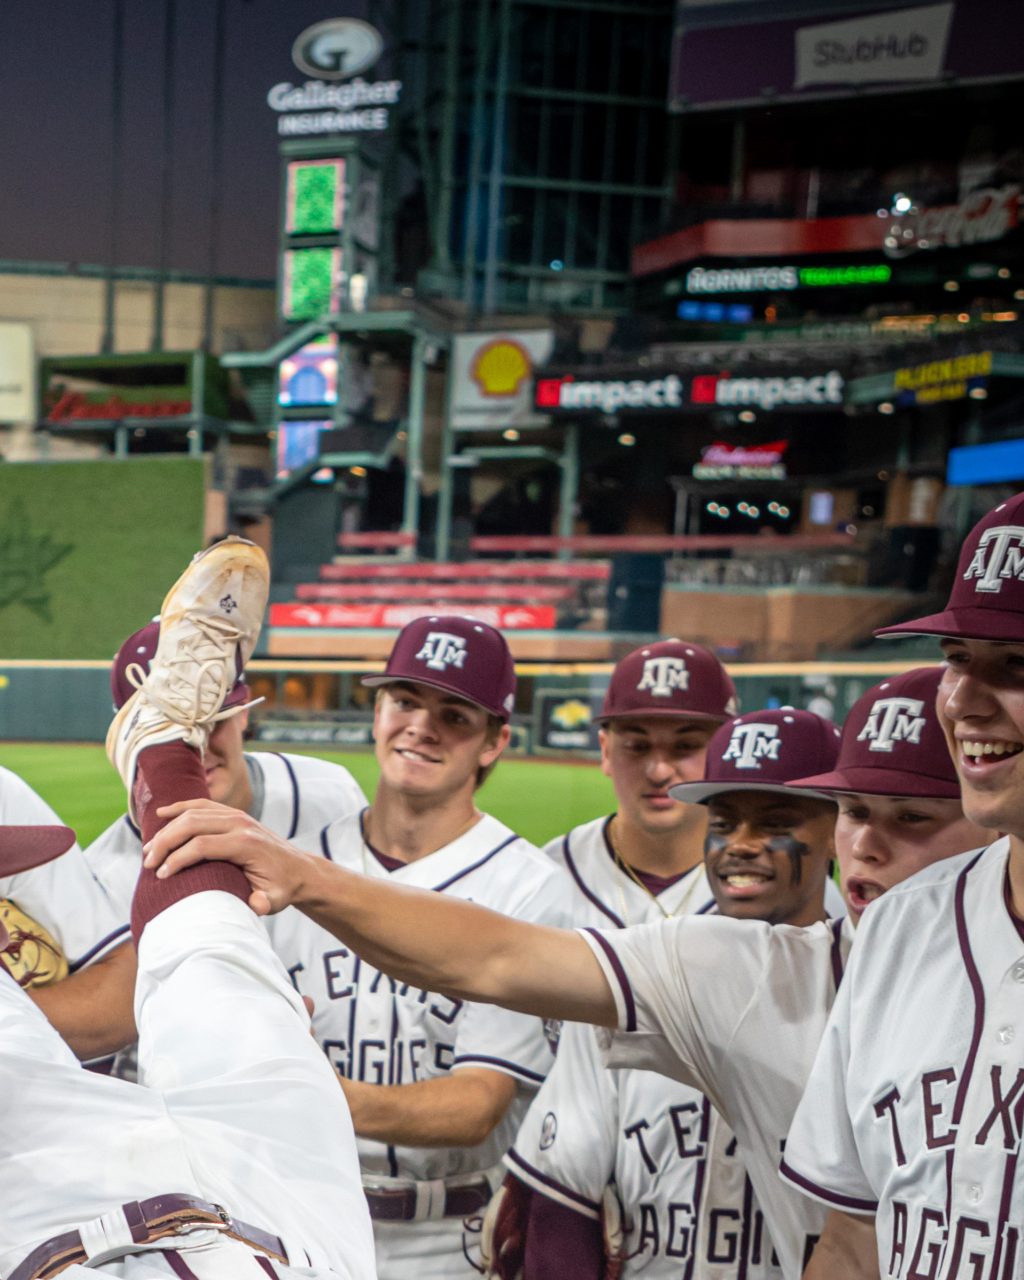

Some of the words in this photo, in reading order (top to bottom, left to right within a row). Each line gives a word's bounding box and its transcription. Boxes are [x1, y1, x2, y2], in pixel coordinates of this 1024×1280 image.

[813, 30, 929, 67] StubHub
[267, 77, 403, 112] Gallagher
[558, 373, 683, 414] impact
[714, 369, 844, 411] impact
